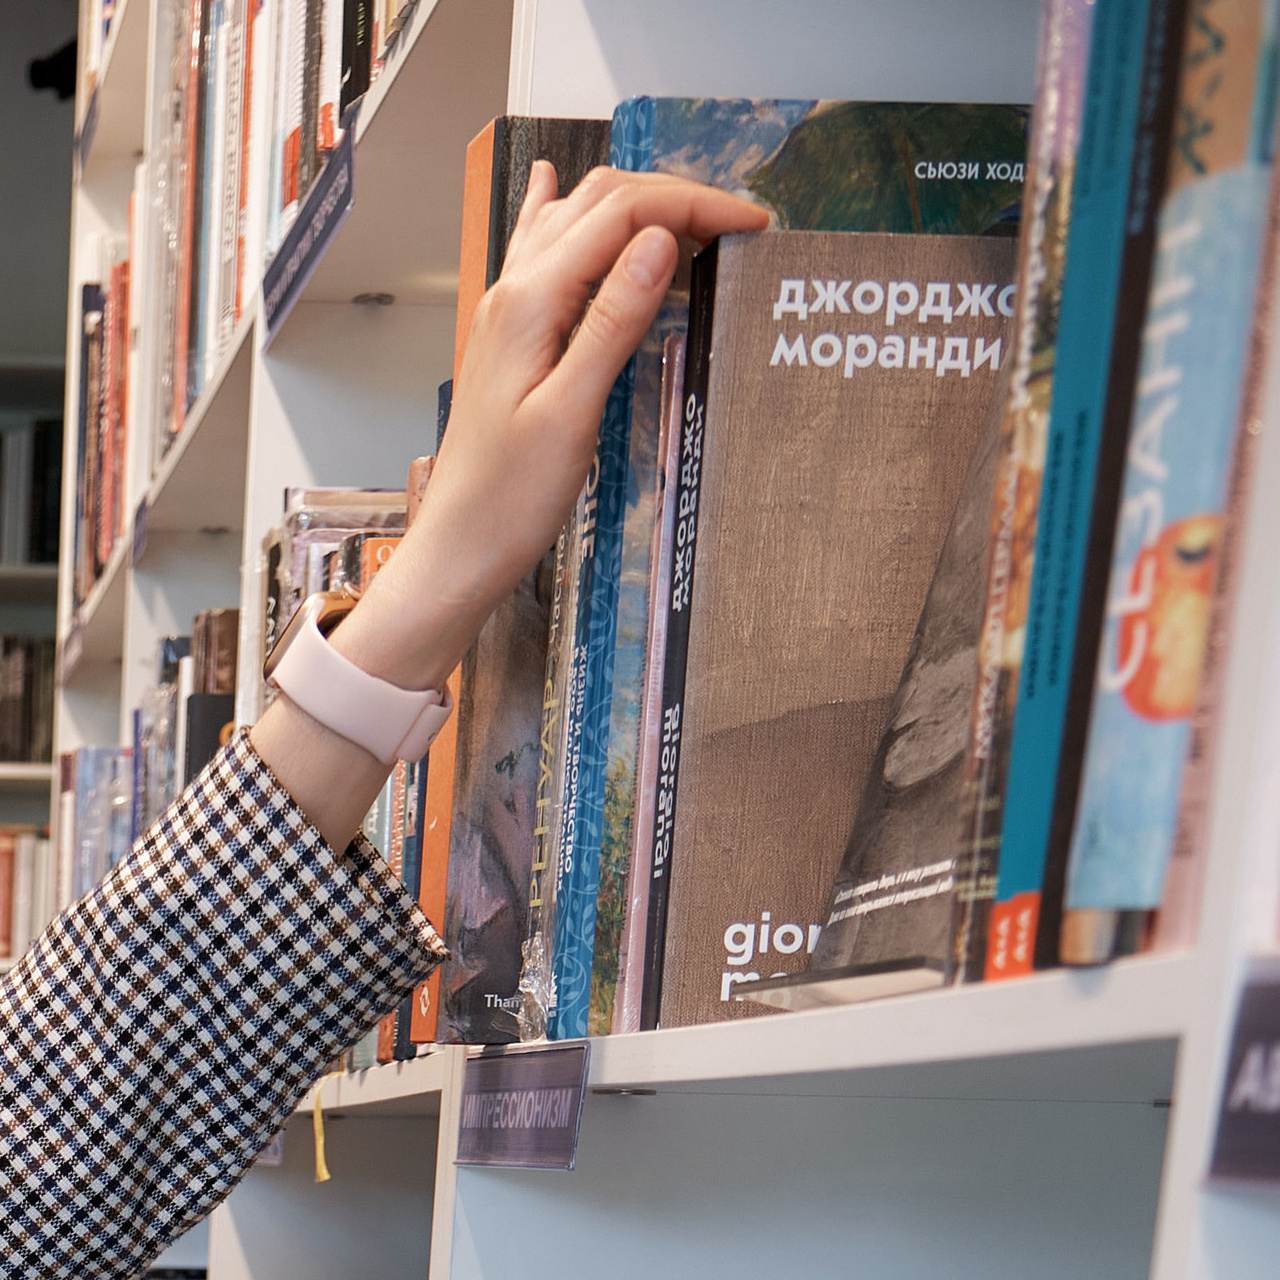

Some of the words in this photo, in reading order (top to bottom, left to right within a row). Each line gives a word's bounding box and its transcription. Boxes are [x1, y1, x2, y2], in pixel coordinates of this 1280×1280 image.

[914, 161, 979, 181] СЬЮЗИ
[985, 162, 1028, 184] ХОД
[771, 333, 1005, 378] моранди
[773, 278, 1018, 325] джорджо
[578, 450, 601, 564] ОНЕ
[673, 392, 697, 611] джорджо
[682, 401, 704, 604] моранди
[548, 522, 570, 643] Частна
[574, 645, 588, 717] ЖИЗНЬ
[574, 725, 582, 738] И
[529, 674, 560, 907] РЕНУАР
[561, 742, 582, 872] ТВОРЧЕСТВО
[651, 706, 674, 878] morandi
[658, 702, 681, 858] giorgio
[723, 911, 822, 966] gior
[461, 1093, 572, 1131] ИМПРЕССИОНИЗМ
